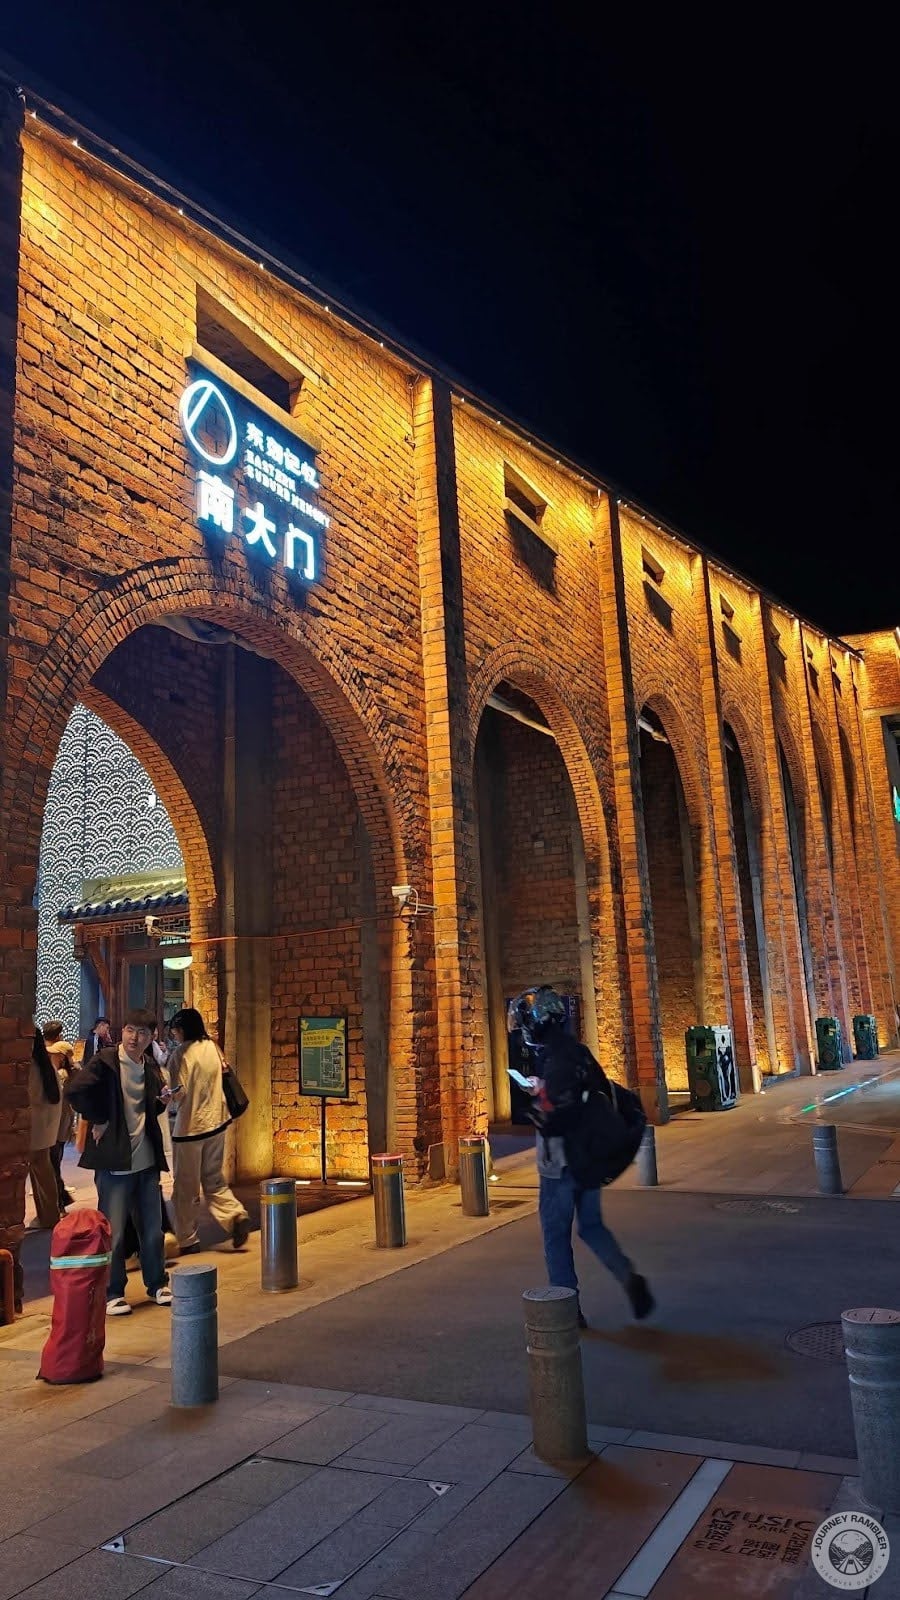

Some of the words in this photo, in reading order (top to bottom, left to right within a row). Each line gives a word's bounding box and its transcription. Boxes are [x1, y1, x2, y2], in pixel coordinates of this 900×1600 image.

[196, 469, 315, 580] 南大门
[711, 1507, 816, 1532] MUSIC
